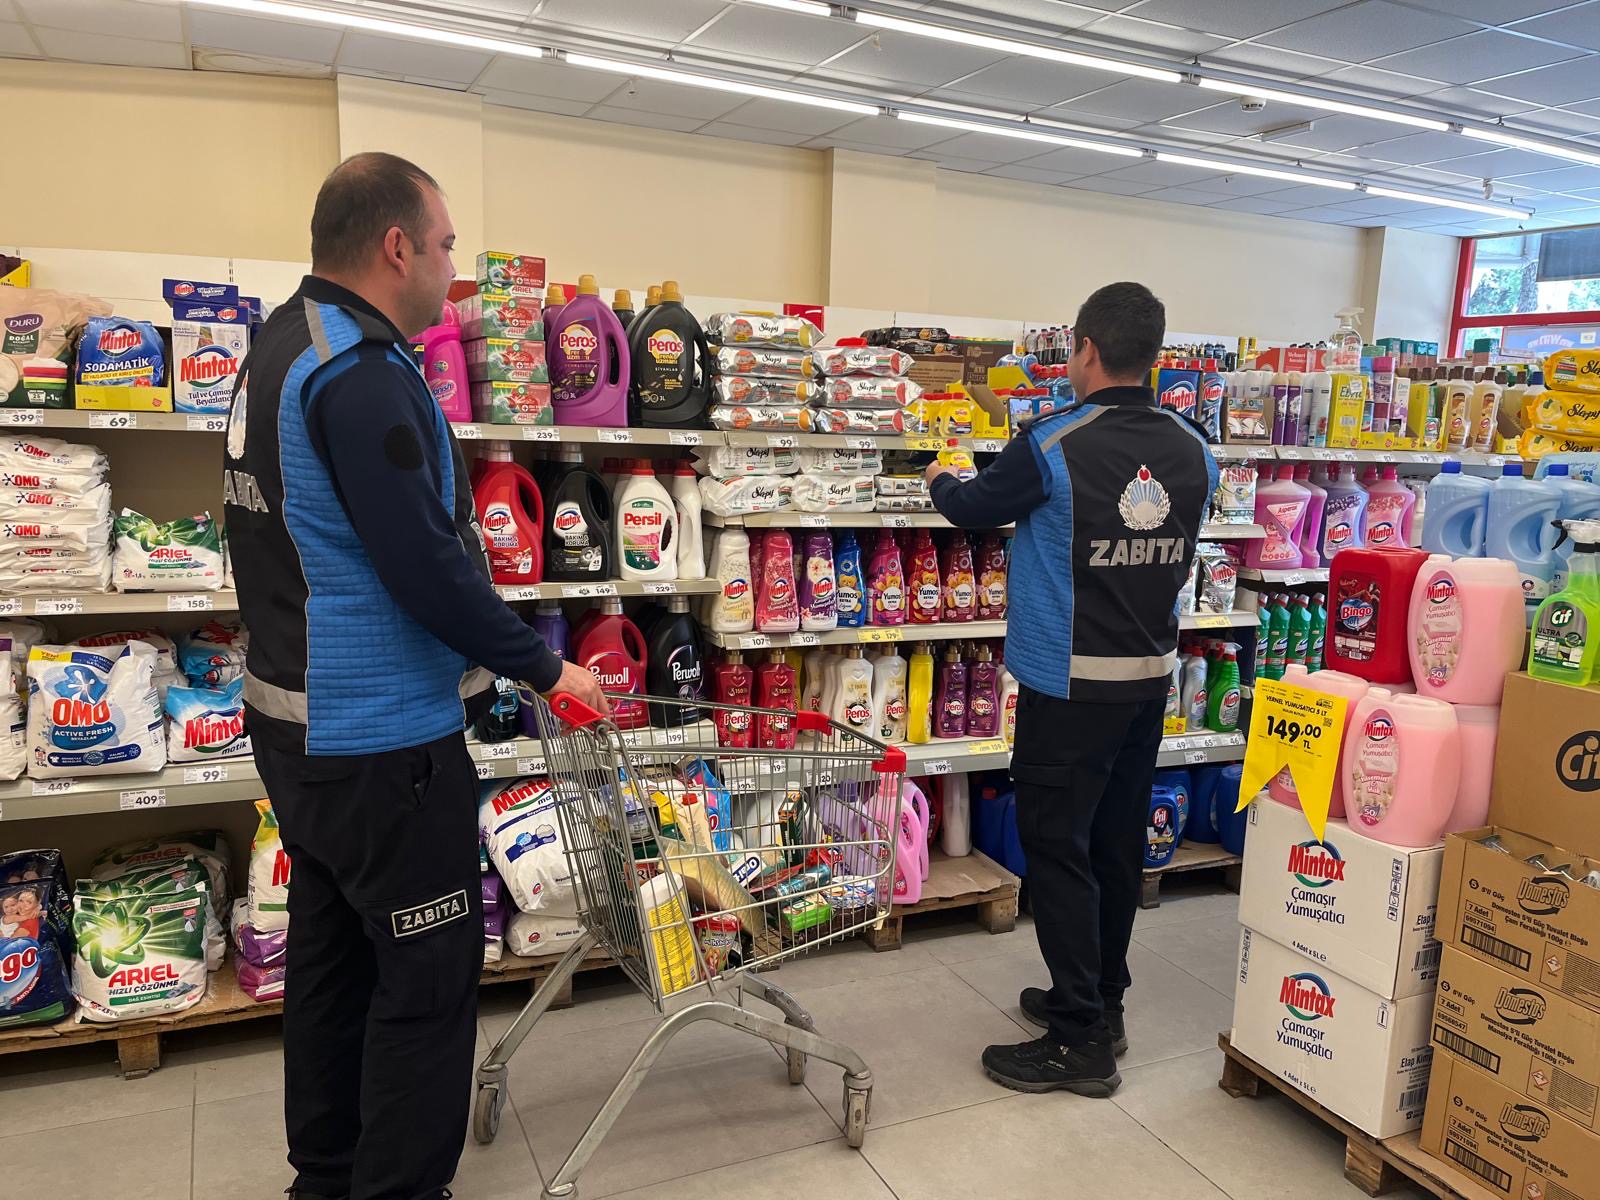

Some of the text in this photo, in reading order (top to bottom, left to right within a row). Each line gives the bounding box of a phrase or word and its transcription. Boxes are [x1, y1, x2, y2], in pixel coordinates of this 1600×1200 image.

[10, 317, 39, 327] DURU
[98, 331, 142, 350] Mintax
[560, 334, 596, 348] Peros
[648, 338, 683, 352] Peros
[85, 357, 149, 371] SODAMATİK
[181, 356, 238, 382] Mintax
[110, 418, 127, 426] 69
[207, 421, 223, 430] 89
[780, 439, 792, 447] 99
[26, 445, 51, 458] OMO
[746, 448, 770, 459] Sleepy
[833, 448, 857, 460] Sleepy
[15, 475, 40, 486] OMO
[1226, 468, 1253, 483] FAIRY
[752, 486, 774, 499] Sleepy
[828, 484, 850, 496] Sleepy
[28, 494, 53, 504] OMO
[485, 516, 510, 528] Mintax
[556, 515, 580, 529] Mintax
[624, 512, 662, 526] Persil
[16, 525, 40, 535] OMO
[1328, 527, 1352, 540] Mintax
[1368, 527, 1394, 540] Mintax
[149, 548, 192, 558] ARIEL
[1089, 537, 1185, 567] ZABITA
[724, 584, 748, 596] Mintax
[769, 585, 789, 596] Mintax
[836, 590, 858, 599] Yumos
[919, 588, 939, 596] Yumos
[1427, 585, 1454, 599] Mintax
[55, 603, 74, 611] 199
[1342, 606, 1372, 619] Bingo
[1552, 609, 1572, 624] Cif
[1538, 628, 1560, 636] ULTRA
[752, 638, 765, 646] 107
[801, 636, 814, 644] 107
[1266, 695, 1283, 704] VERNEL
[886, 704, 906, 714] Peros
[945, 703, 964, 712] Peros
[972, 702, 993, 710] Peros
[53, 699, 110, 726] OMO
[846, 708, 870, 719] Peros
[86, 727, 113, 736] FRESH
[1267, 716, 1321, 743] 149,00
[1365, 724, 1393, 736] Mintax
[1176, 741, 1186, 749] 49
[1303, 740, 1311, 749] TL
[493, 748, 510, 756] 344
[1194, 754, 1204, 762] 139
[529, 762, 546, 771] 349
[935, 764, 947, 772] 199
[203, 770, 219, 780] 99
[136, 796, 157, 804] 409
[1287, 844, 1346, 882] Mintax
[1291, 886, 1337, 907] Çamaşır
[1517, 877, 1569, 908] Domestos
[402, 899, 460, 930] ZABITA
[1285, 901, 1345, 925] Yumuşatıcı
[1474, 906, 1489, 917] Adet
[1417, 915, 1430, 925] Etap
[1492, 902, 1588, 946] Domestos Güç Tuvalet Bloğu
[1504, 916, 1563, 945] Çam 100g
[1297, 941, 1309, 954] Adet
[109, 963, 179, 987] ARIEL
[109, 980, 179, 995] HIZLI ÇÖZÜNME
[1279, 976, 1336, 1019] Mintax
[1494, 987, 1546, 1019] Domestos
[1446, 1000, 1461, 1013] Adet
[1282, 1017, 1326, 1041] Çamaşır
[1481, 1013, 1574, 1065] Domestos Güç Tuvalet Bloğu
[1488, 1024, 1557, 1065] Manolya 100g
[1276, 1030, 1333, 1061] Yumuşatıcı
[1401, 1058, 1414, 1067] Etap
[1288, 1073, 1300, 1086] Adet
[1499, 1102, 1550, 1138] Domestos
[1458, 1122, 1472, 1134] Adet
[1475, 1121, 1502, 1141] Domestos
[1526, 1149, 1549, 1168] Tuvalet
[1487, 1136, 1544, 1174] Çam 100g
